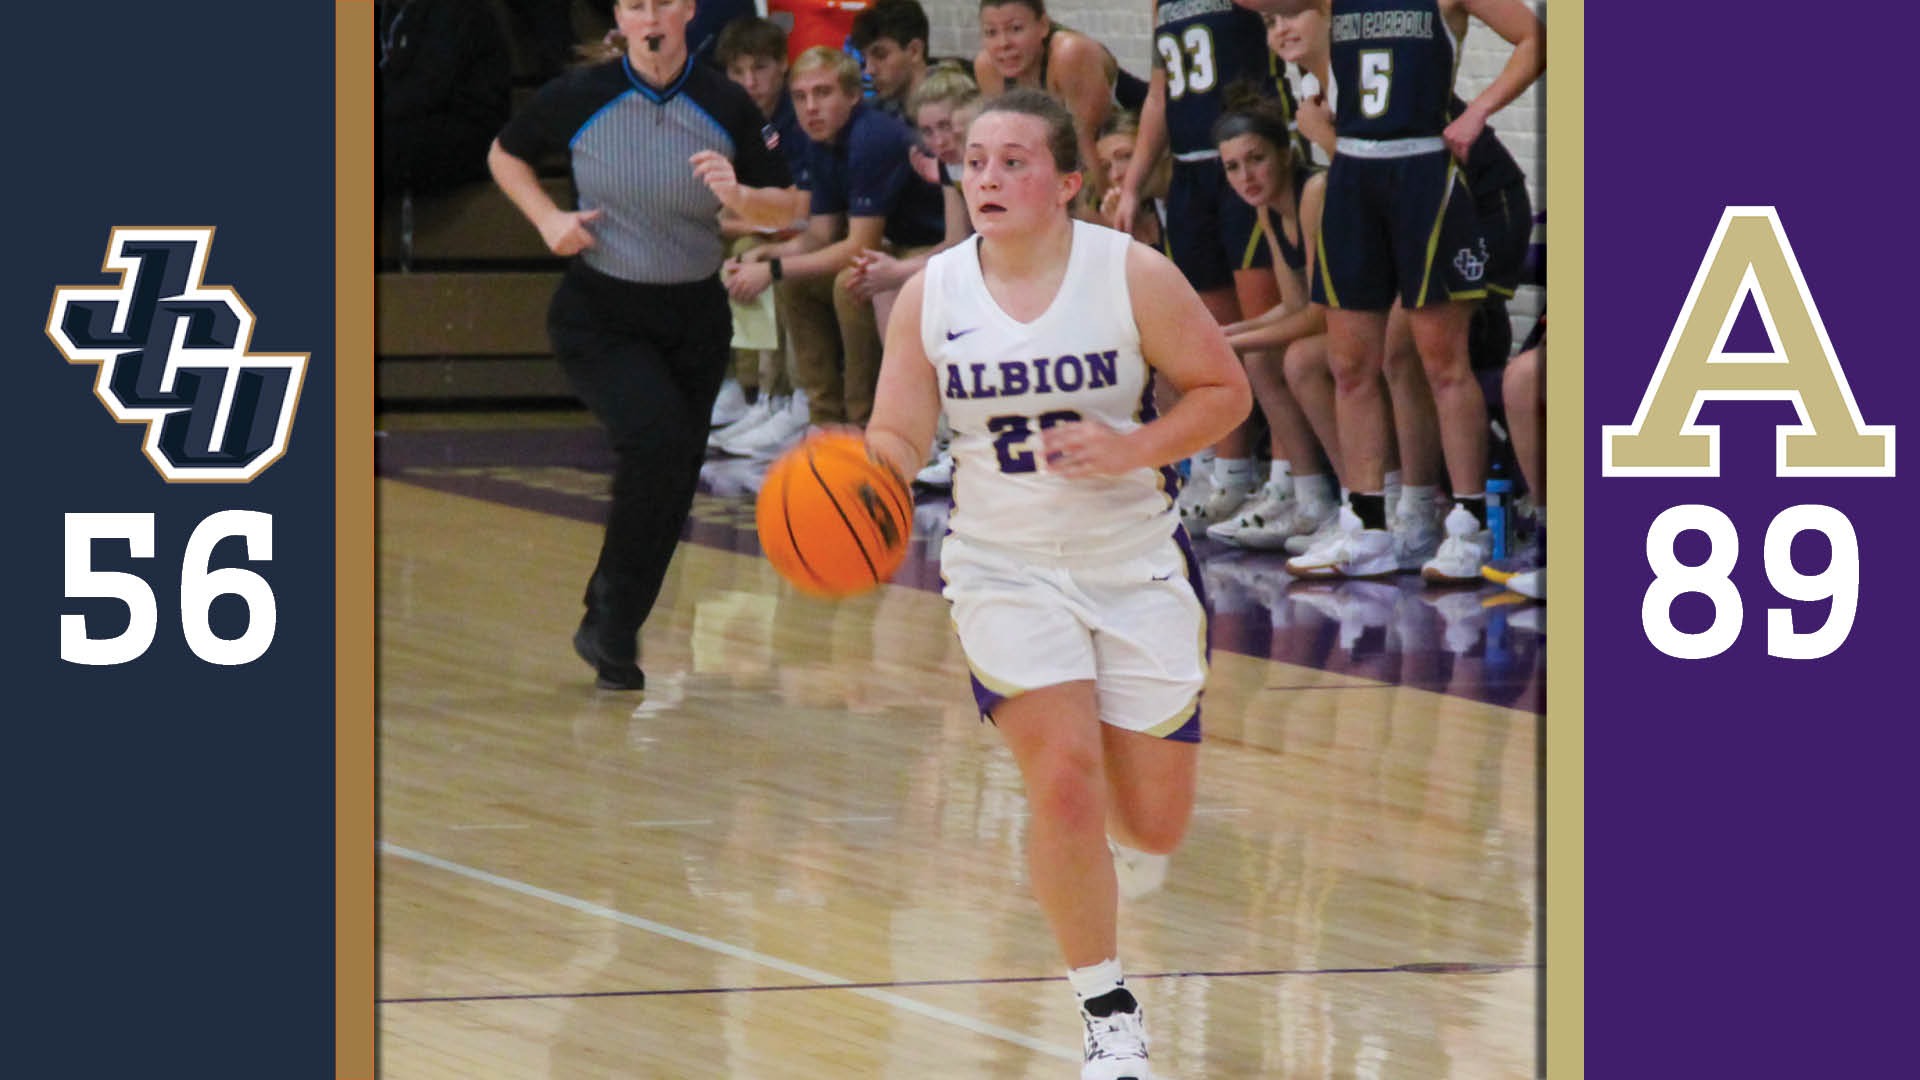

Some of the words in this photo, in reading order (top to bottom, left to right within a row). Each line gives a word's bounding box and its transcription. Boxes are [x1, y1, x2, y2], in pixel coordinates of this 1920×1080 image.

[1332, 13, 1361, 42] OHN
[1362, 10, 1433, 39] CARROLL
[1156, 24, 1217, 100] 33
[1359, 48, 1393, 119] 5
[946, 349, 1119, 400] ALBION
